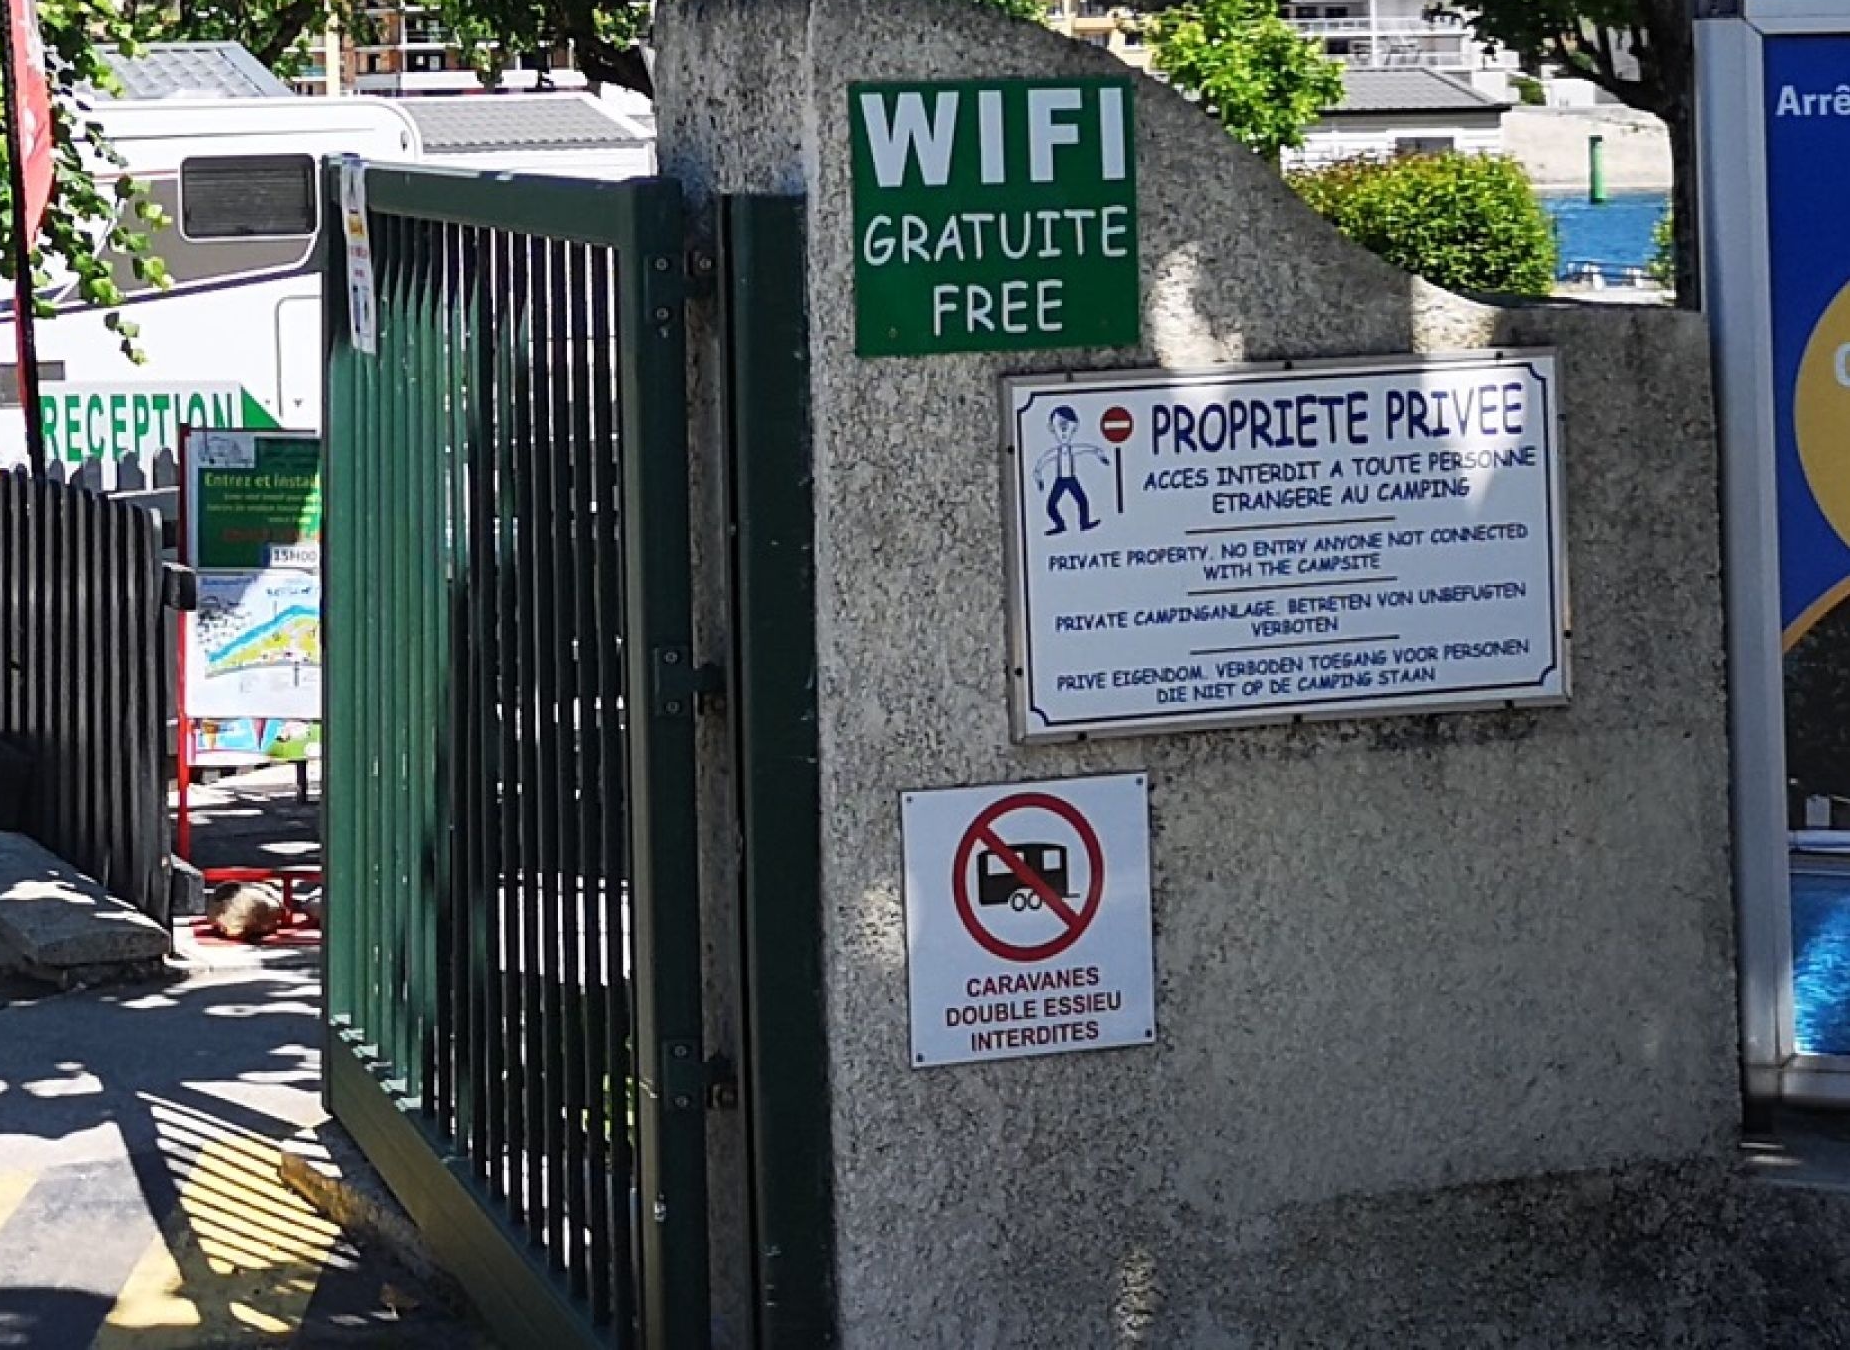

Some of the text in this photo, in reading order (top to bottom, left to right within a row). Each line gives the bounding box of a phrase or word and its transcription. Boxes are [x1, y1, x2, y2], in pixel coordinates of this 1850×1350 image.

[861, 87, 1126, 187] WIFI
[863, 205, 1127, 266] GRATUITE
[933, 280, 1064, 336] FREE
[38, 392, 232, 461] RECEPTION
[1151, 382, 1523, 454] PROPRIETE PRIVEE
[1143, 447, 1535, 491] ACCES INTERDIT A TOUTE PERSONNE
[1213, 478, 1470, 513] ETRANGERE AU CAMPING
[1049, 551, 1120, 571] PRIVATE
[1221, 542, 1247, 559] NO
[1253, 538, 1307, 558] ENTRY
[1314, 532, 1382, 552] ANYONE
[1388, 530, 1424, 547] NOT
[1430, 523, 1528, 543] CONNECTED
[1203, 553, 1381, 581] WITH THE CAMPSITE
[1055, 611, 1128, 632] PRIVATE
[1288, 594, 1371, 614] BETRETEN
[1377, 590, 1413, 607] VON
[1419, 582, 1526, 604] UNBEFUGTEN
[1251, 617, 1338, 637] VERBOTEN
[1057, 672, 1106, 691] PRIVE
[1215, 658, 1303, 678] VERBODEN
[1310, 651, 1387, 670] TOEGANG
[1393, 646, 1438, 663] VOOR
[1444, 638, 1529, 661] PERSONEN
[1156, 667, 1436, 704] DIE NIET OP DE CAMPING STAAN
[967, 966, 1099, 998] CARAVANES
[946, 991, 1121, 1027] DOUBLE ESSIEU
[972, 1021, 1099, 1051] INTERDITES
